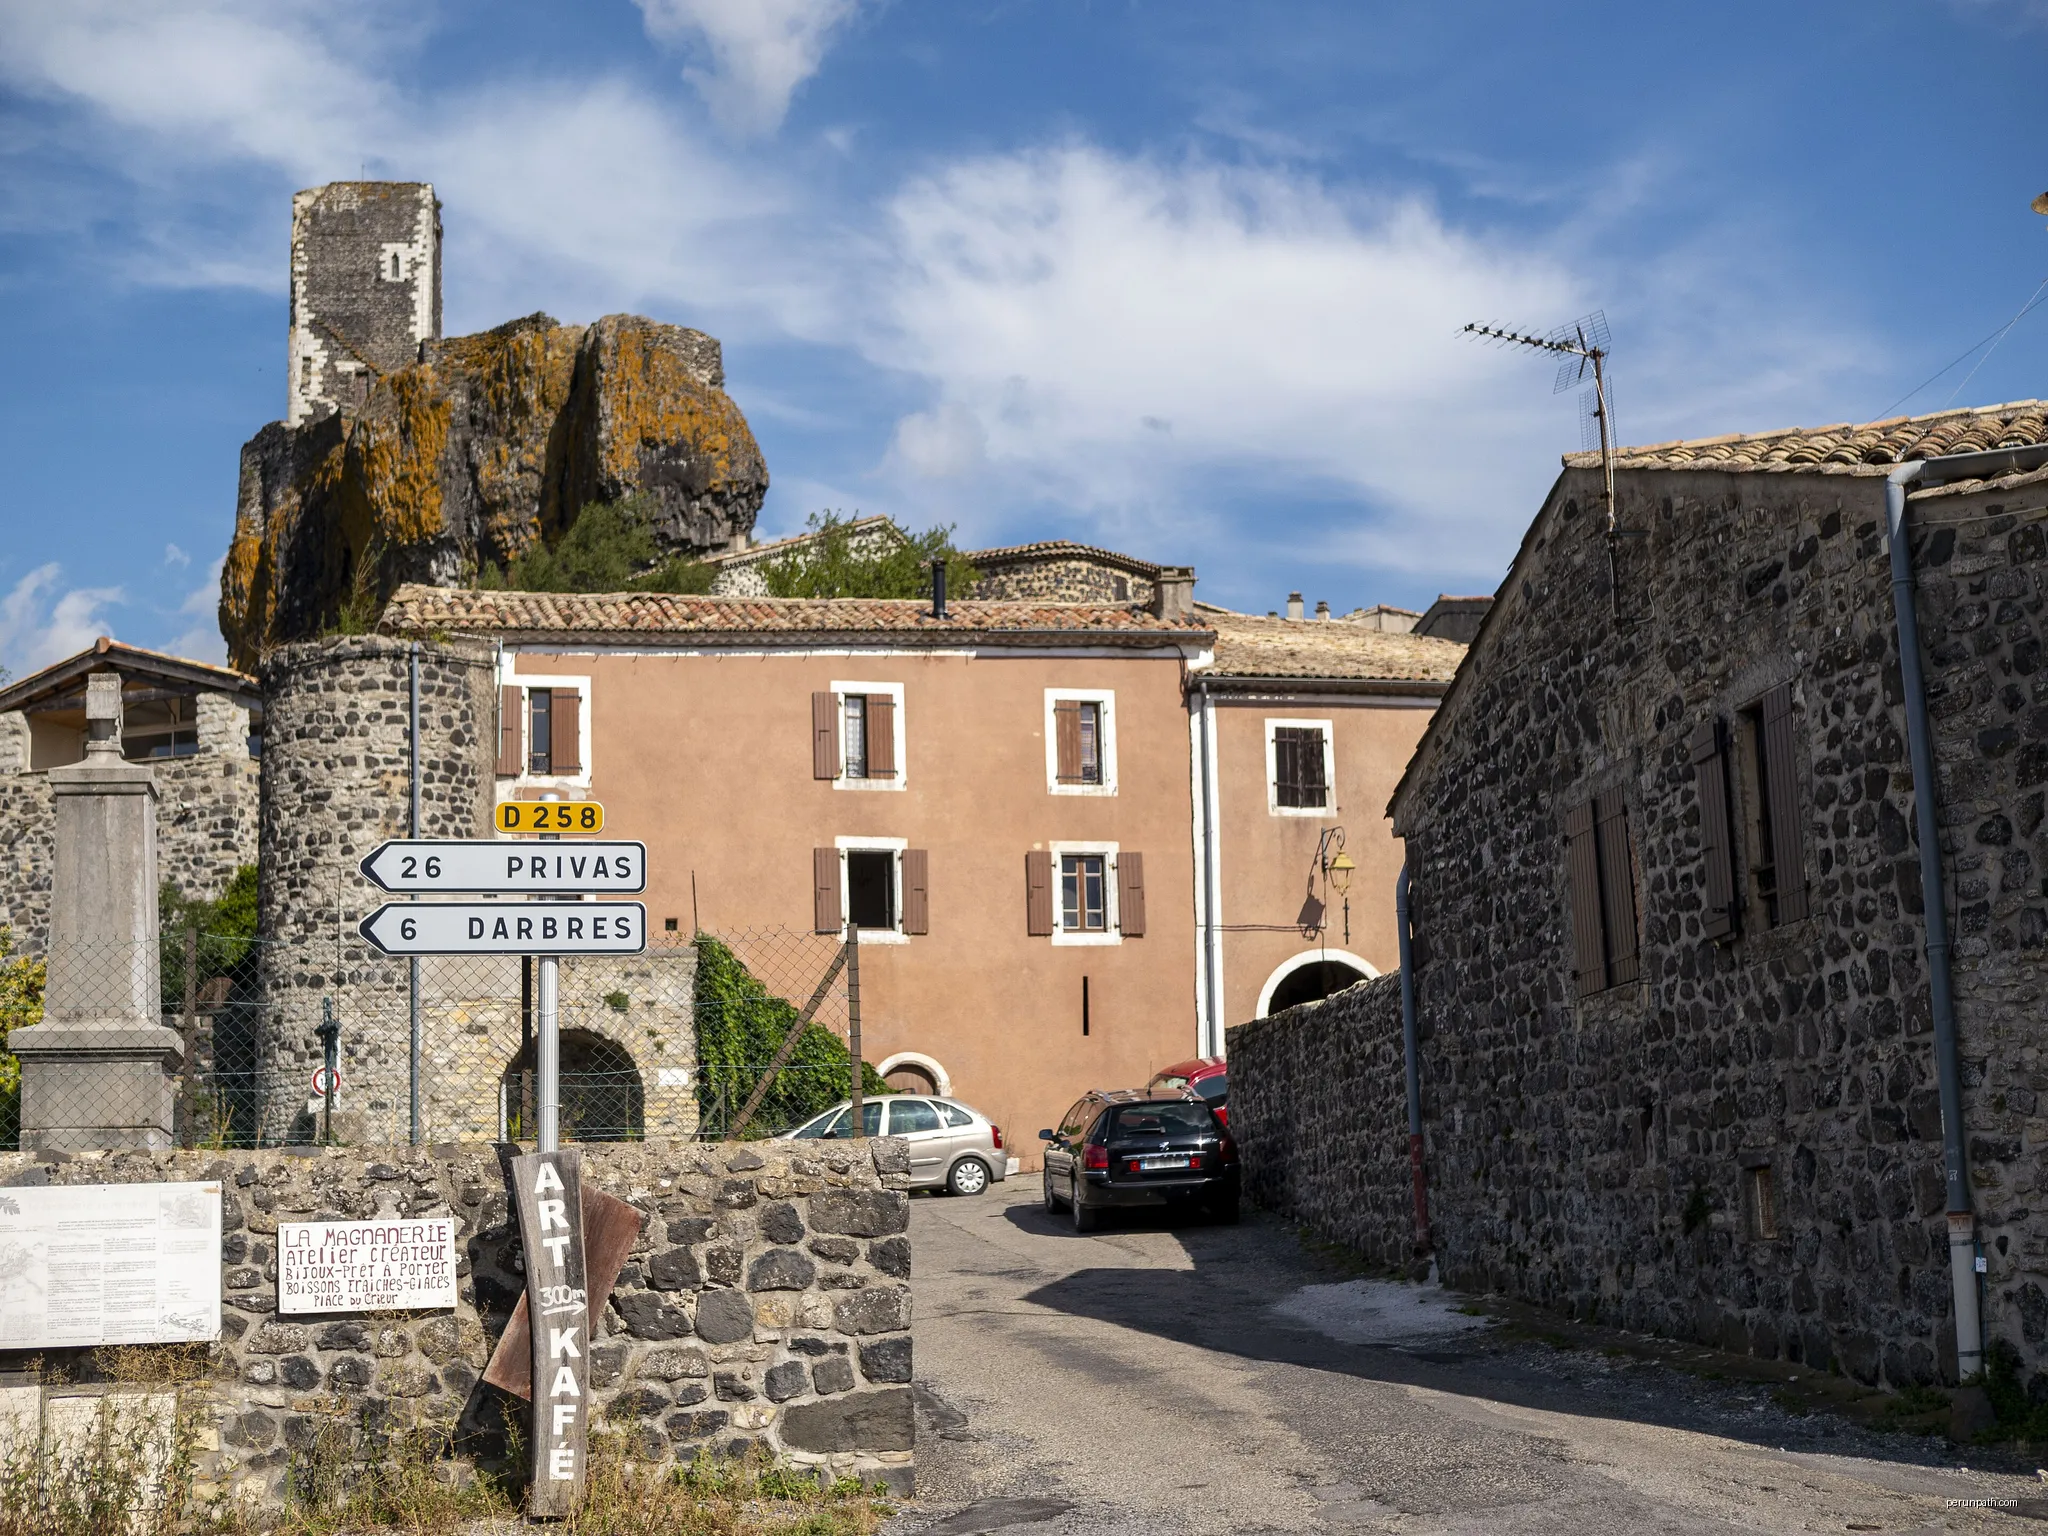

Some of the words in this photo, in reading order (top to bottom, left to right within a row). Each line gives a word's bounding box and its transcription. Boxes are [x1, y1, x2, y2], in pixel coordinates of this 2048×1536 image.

[504, 806, 521, 828] D
[533, 806, 596, 829] 258
[401, 856, 442, 879] 26
[507, 856, 632, 879] PRIVAS
[400, 918, 418, 941] 6
[468, 917, 632, 940] DARBRES
[534, 1162, 572, 1268] ART
[285, 1229, 311, 1247] LA
[540, 1284, 586, 1309] 300m
[549, 1327, 582, 1481] KAFÉ
